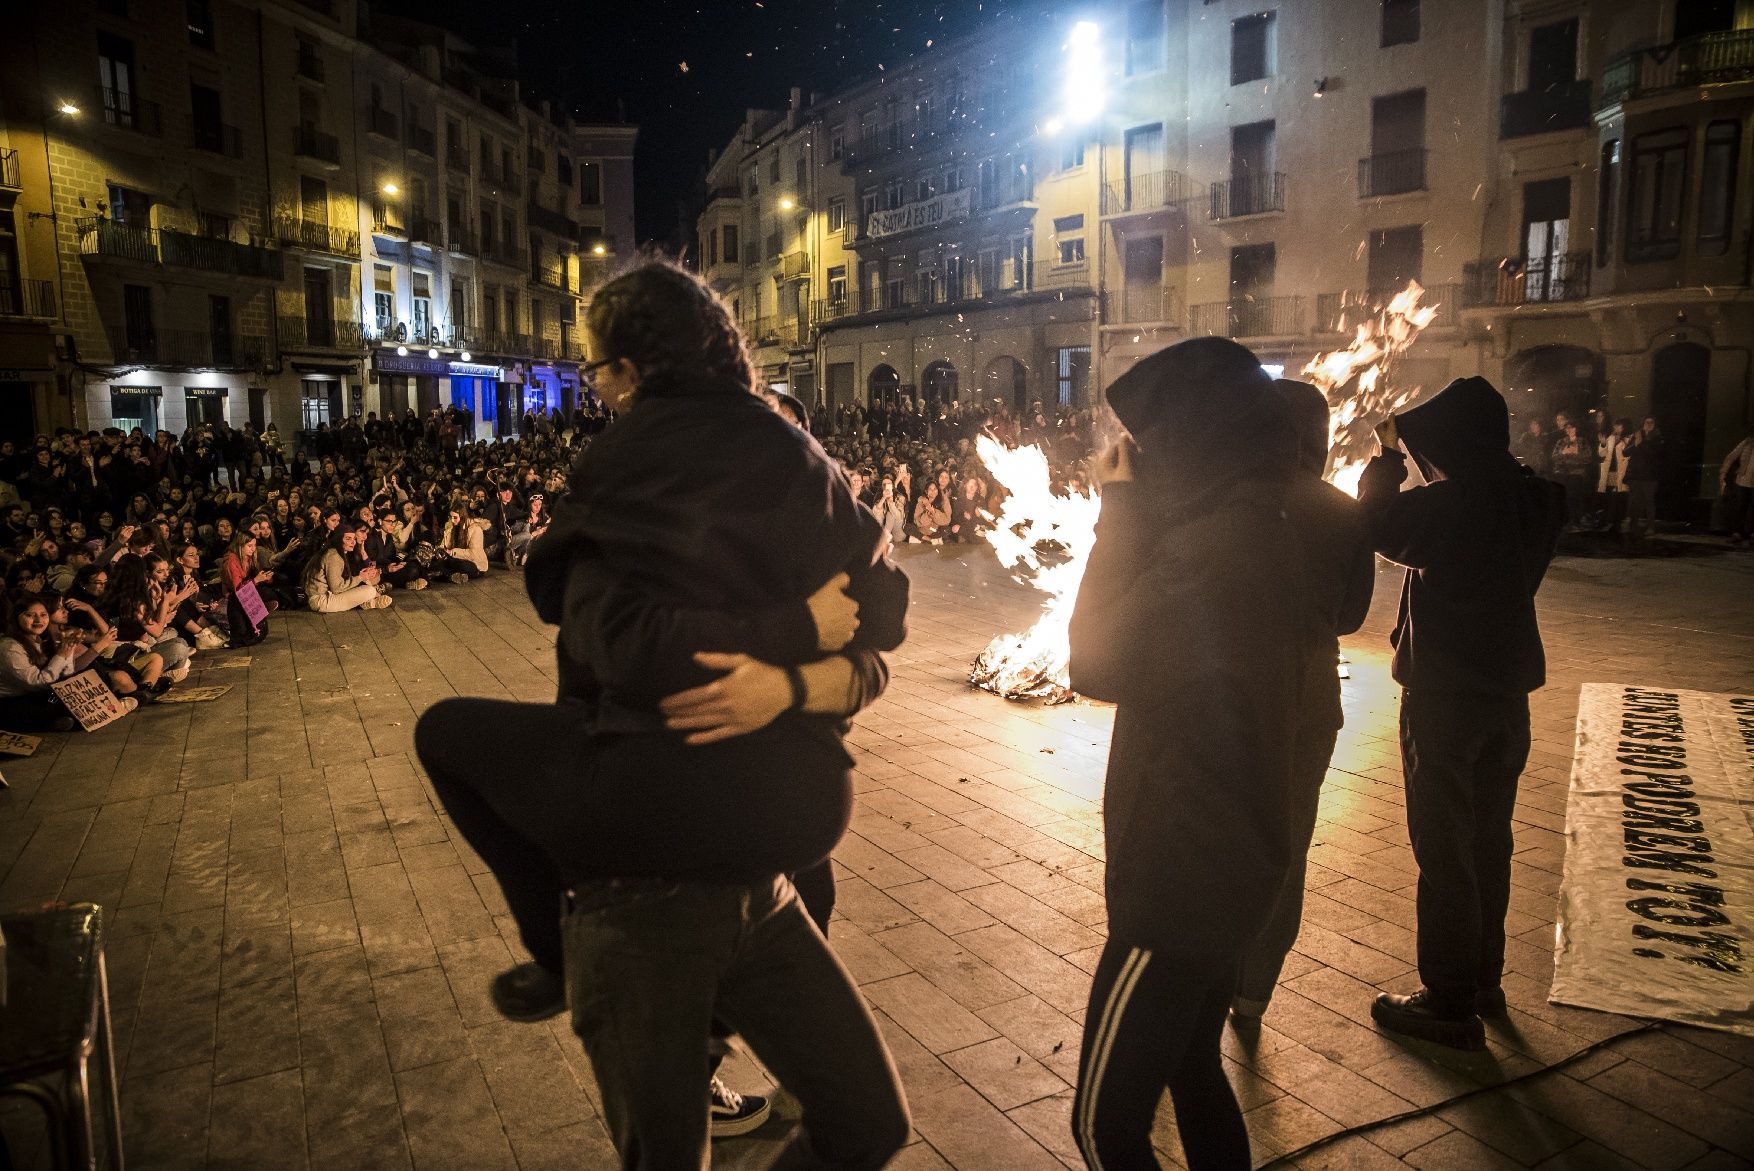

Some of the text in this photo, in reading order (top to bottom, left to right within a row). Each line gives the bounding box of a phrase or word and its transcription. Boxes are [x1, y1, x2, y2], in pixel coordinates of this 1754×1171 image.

[71, 680, 84, 690] VA
[83, 676, 92, 687] A
[79, 699, 102, 717] FALTE
[81, 710, 111, 728] NINGUNA
[1621, 687, 1686, 742] JUNTES
[1616, 741, 1688, 769] HO
[1621, 768, 1718, 879] PODREM
